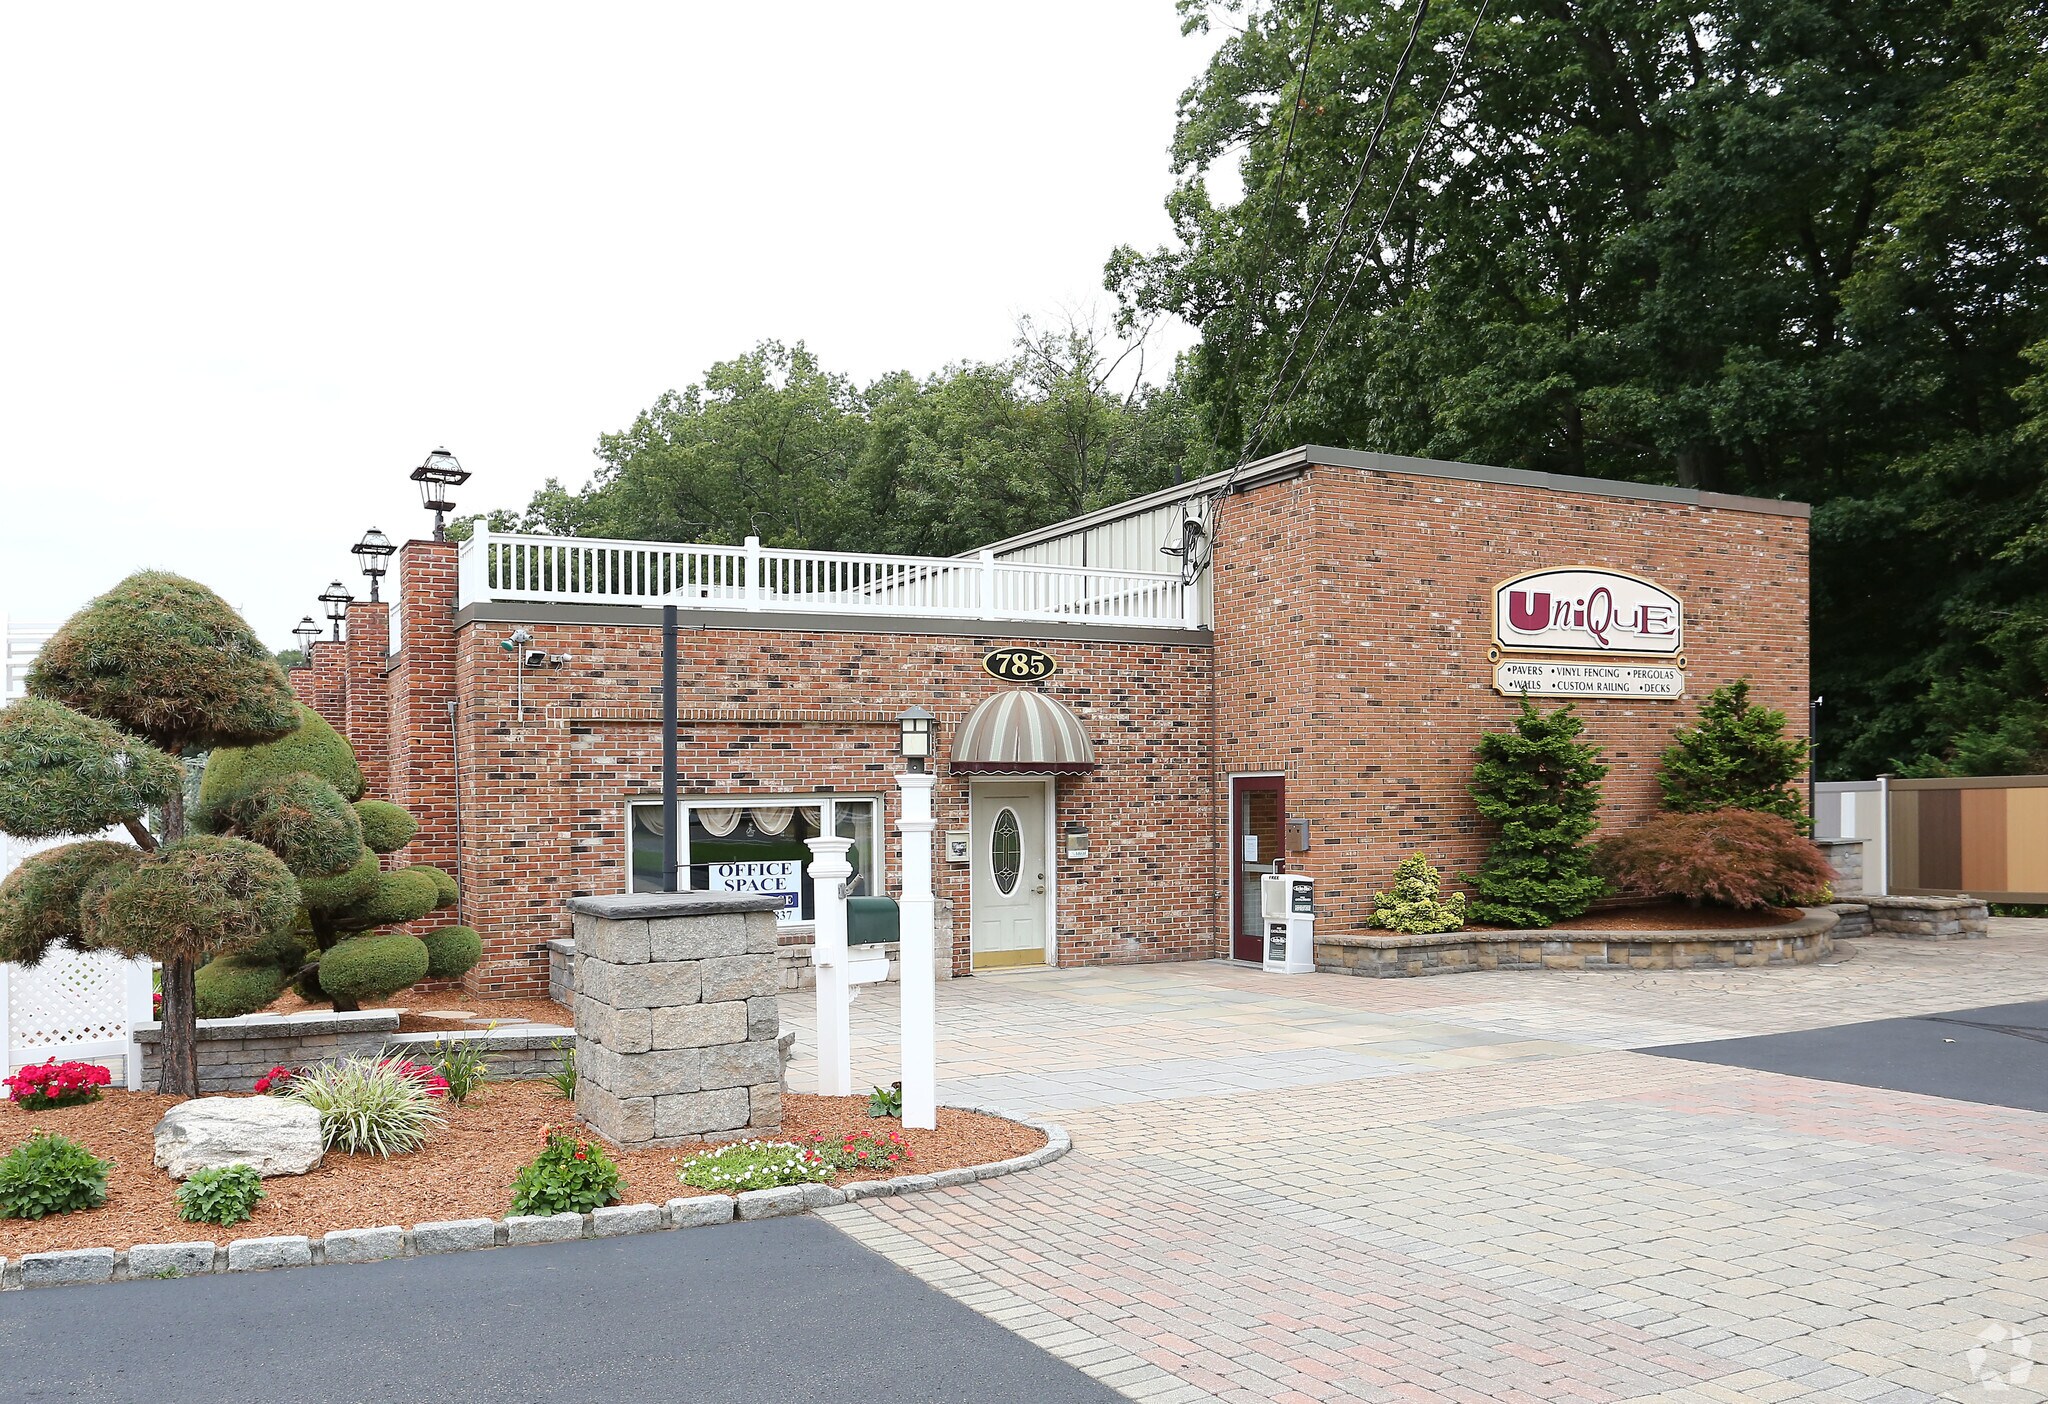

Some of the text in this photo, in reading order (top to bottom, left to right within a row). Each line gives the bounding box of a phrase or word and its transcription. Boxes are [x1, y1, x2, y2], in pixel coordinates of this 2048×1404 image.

[996, 653, 1045, 676] 785
[1512, 665, 1674, 680] PAVERS VINYL FENCING PERGOLAS
[1513, 680, 1671, 693] WALLS CUSTOM RAILING DECKS
[718, 863, 792, 877] OFFICE
[724, 877, 787, 892] SPACE
